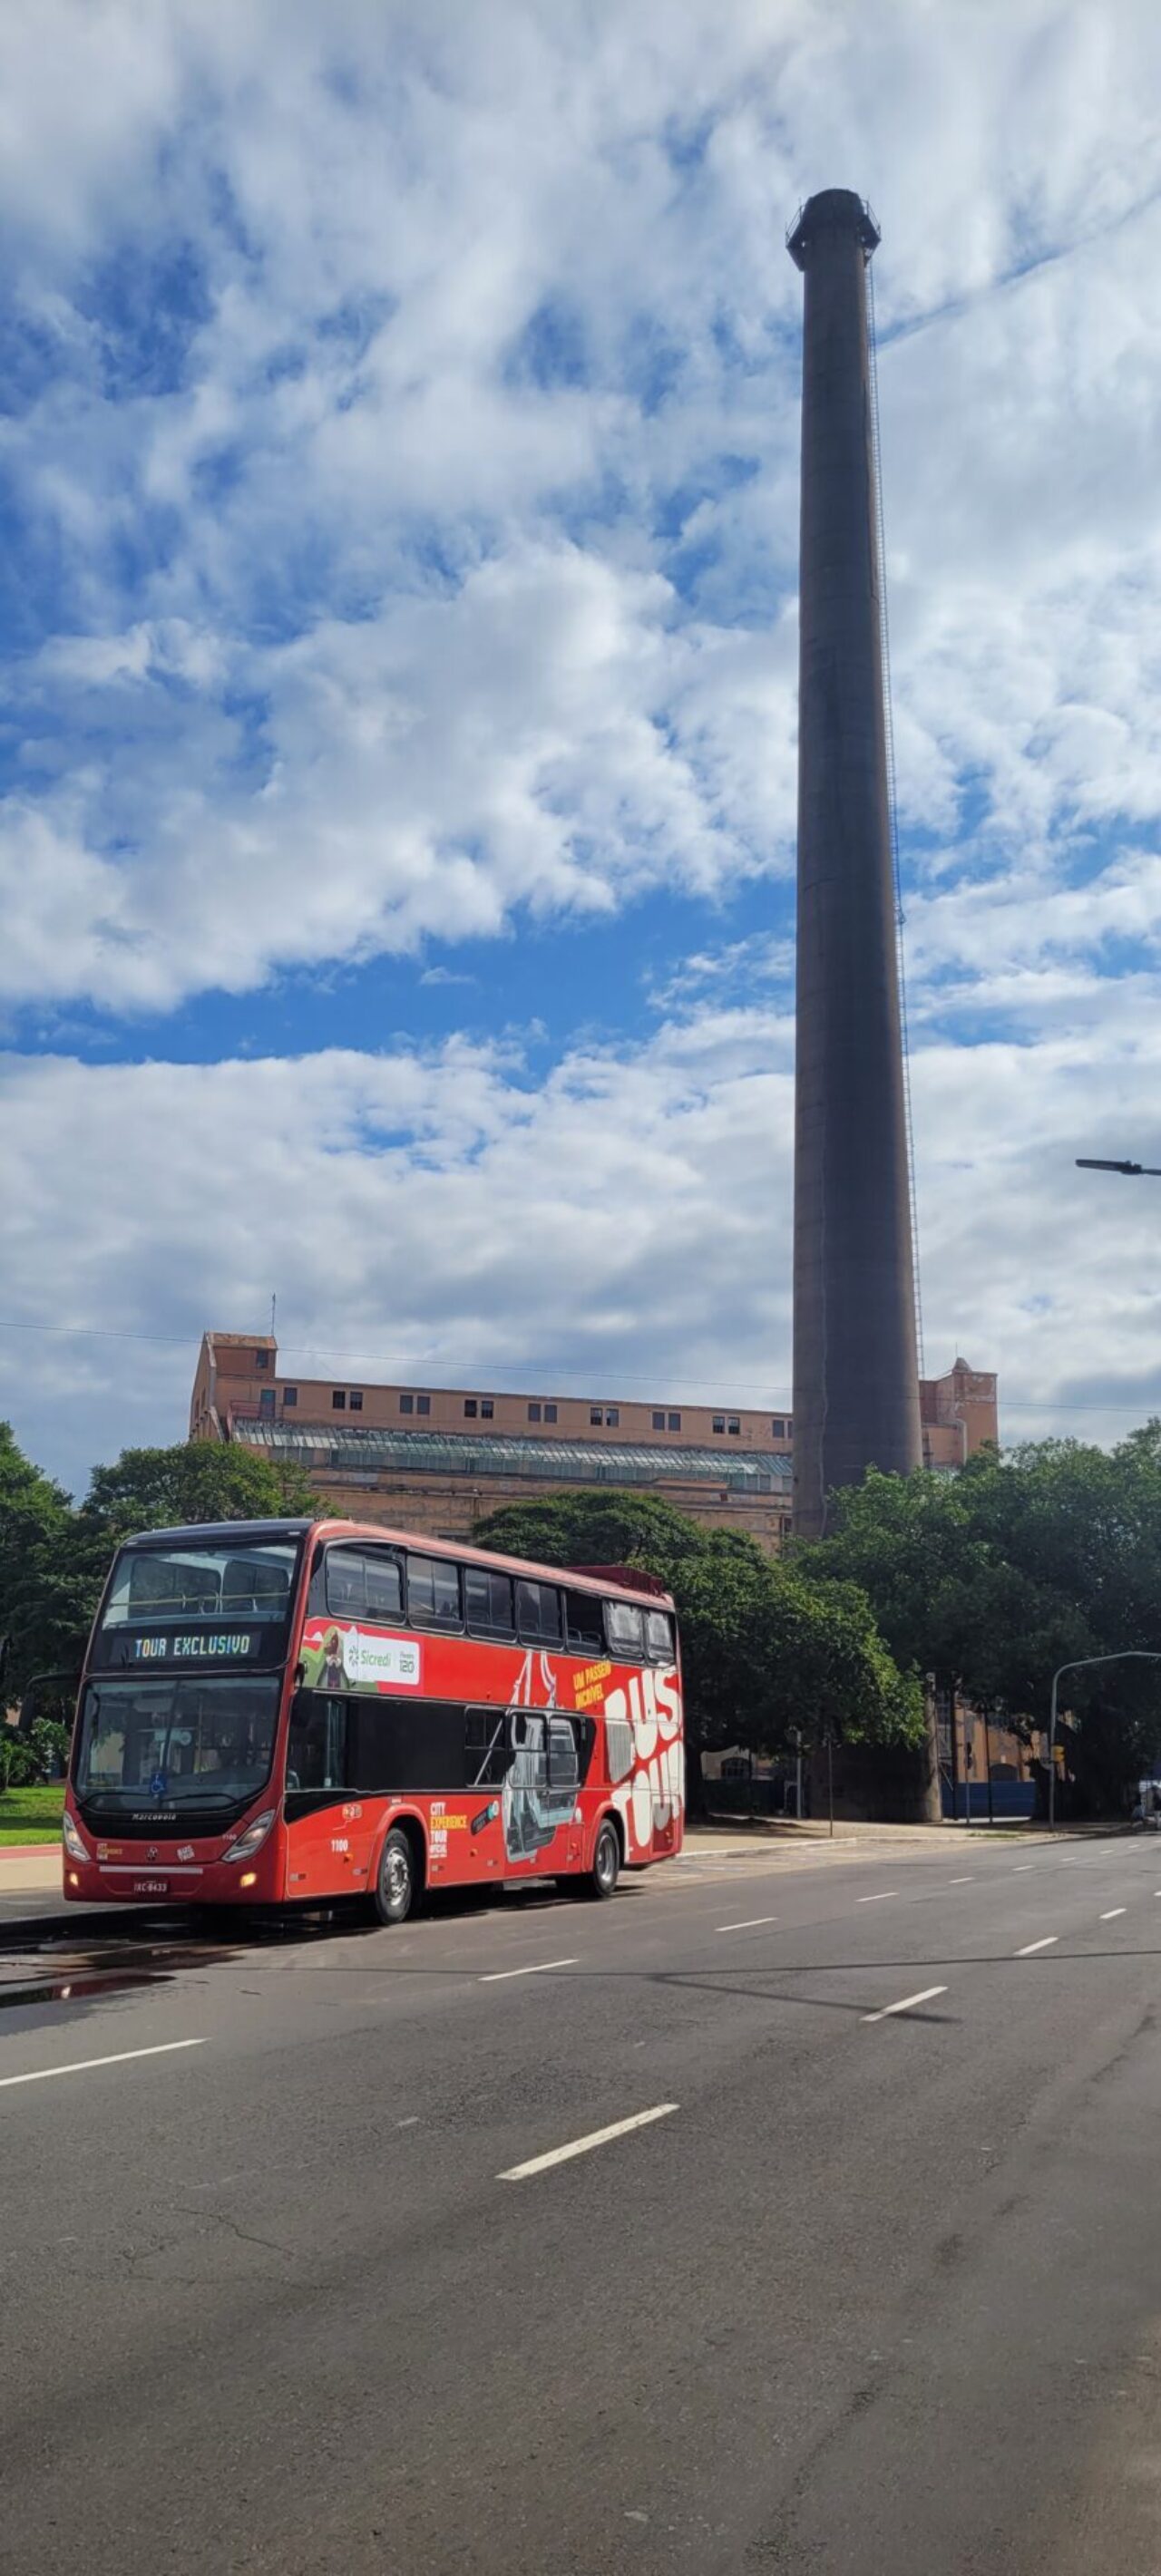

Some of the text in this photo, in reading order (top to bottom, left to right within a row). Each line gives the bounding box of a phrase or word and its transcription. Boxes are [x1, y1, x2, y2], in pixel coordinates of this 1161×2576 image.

[136, 1635, 250, 1657] TOUR EXCLUSIVO
[360, 1648, 392, 1667] Sicredi
[399, 1660, 415, 1674] 120
[573, 1660, 611, 1690] UM PASSEIO
[604, 1666, 682, 1784] BUS
[430, 1802, 446, 1816] CITY
[430, 1815, 468, 1830] EXPERIENCE
[430, 1830, 448, 1844] TOUR
[331, 1839, 348, 1852] 1100
